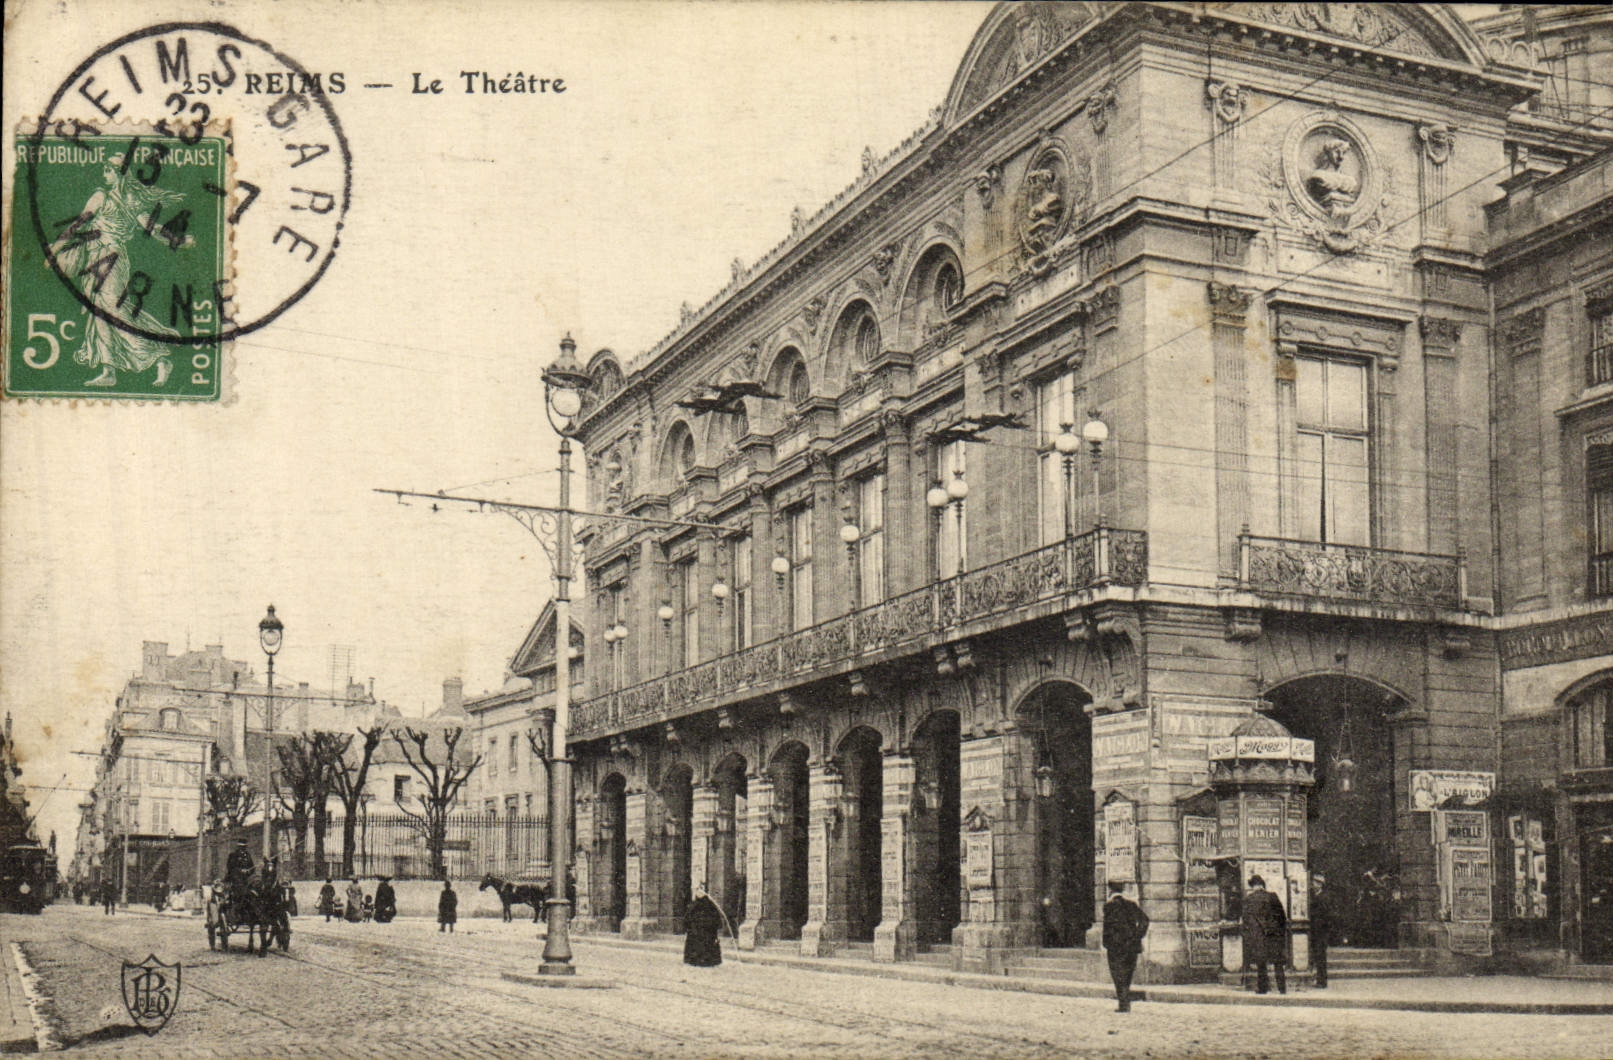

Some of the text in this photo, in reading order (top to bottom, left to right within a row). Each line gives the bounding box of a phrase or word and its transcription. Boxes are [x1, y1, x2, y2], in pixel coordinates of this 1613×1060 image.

[54, 37, 335, 263] REIMS GARE
[133, 147, 216, 168] FRANÇAISE
[52, 210, 238, 326] MARNE
[191, 299, 223, 385] POSTES
